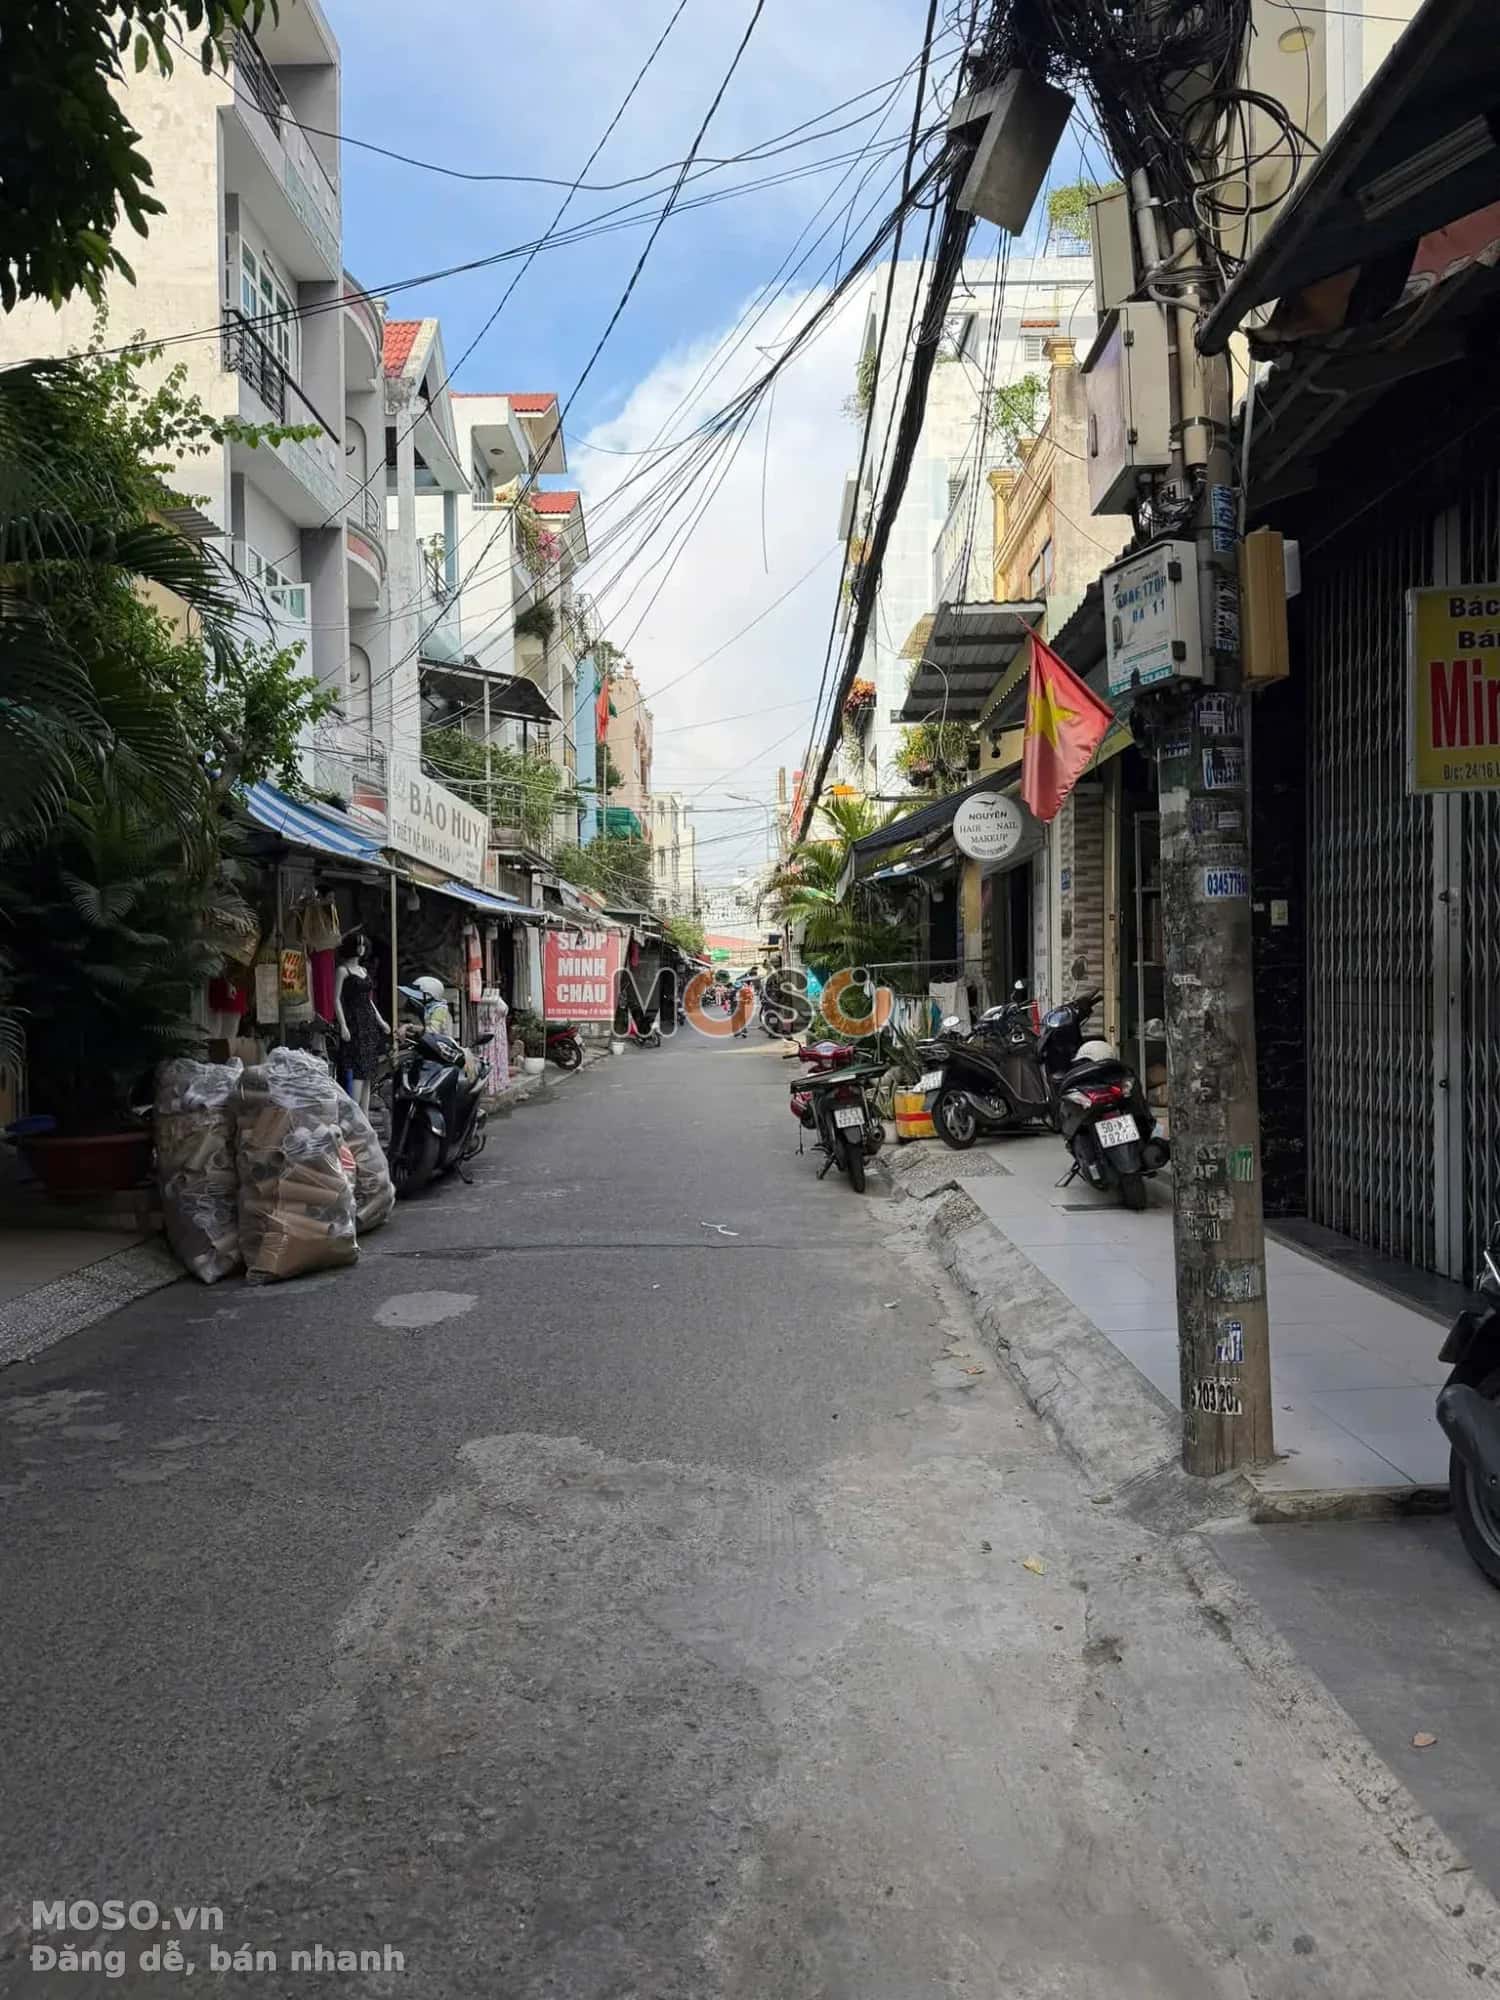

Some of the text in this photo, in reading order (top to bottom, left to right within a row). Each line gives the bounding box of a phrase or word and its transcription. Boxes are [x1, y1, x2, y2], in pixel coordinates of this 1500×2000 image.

[1459, 630, 1500, 649] Bá
[410, 781, 481, 848] BẢO HUY
[996, 821, 1018, 830] NAIL
[558, 957, 607, 977] MINH
[557, 981, 607, 1003] CHÂU
